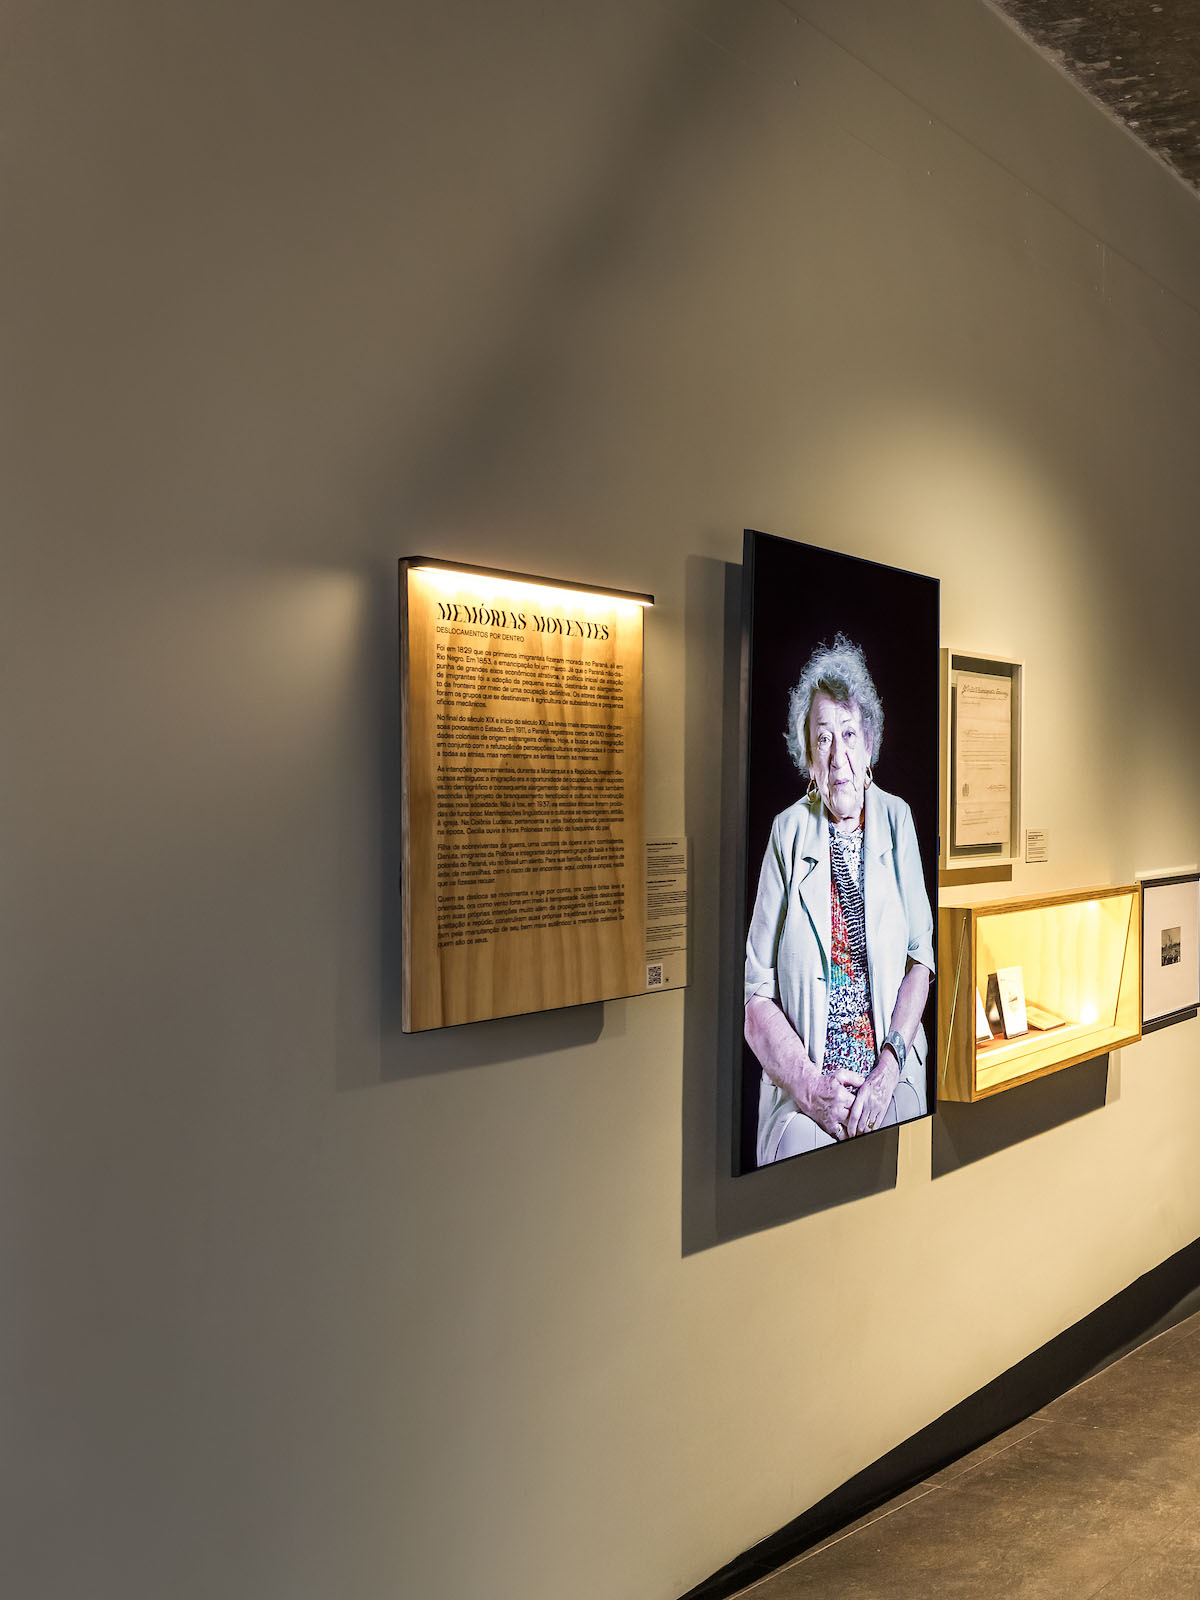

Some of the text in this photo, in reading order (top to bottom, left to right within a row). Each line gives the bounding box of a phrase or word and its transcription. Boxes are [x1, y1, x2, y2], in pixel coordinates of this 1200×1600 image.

[436, 602, 610, 641] MEMÓRIAS MOVENTES
[436, 625, 525, 643] DESLOCAMENTOS POR DENTRO
[436, 643, 445, 651] Foi
[457, 645, 472, 654] 1829
[473, 649, 483, 657] que
[492, 649, 517, 660] primeiros
[518, 652, 545, 663] imigrantes
[436, 652, 445, 660] Rio
[498, 658, 533, 670] emancipação
[436, 661, 454, 672] punha
[465, 664, 488, 675] grandes
[445, 670, 476, 682] imigrantes
[477, 673, 485, 681] foi
[491, 675, 512, 685] adoção
[436, 688, 453, 696] foram
[462, 691, 481, 700] grupos
[476, 684, 486, 692] por
